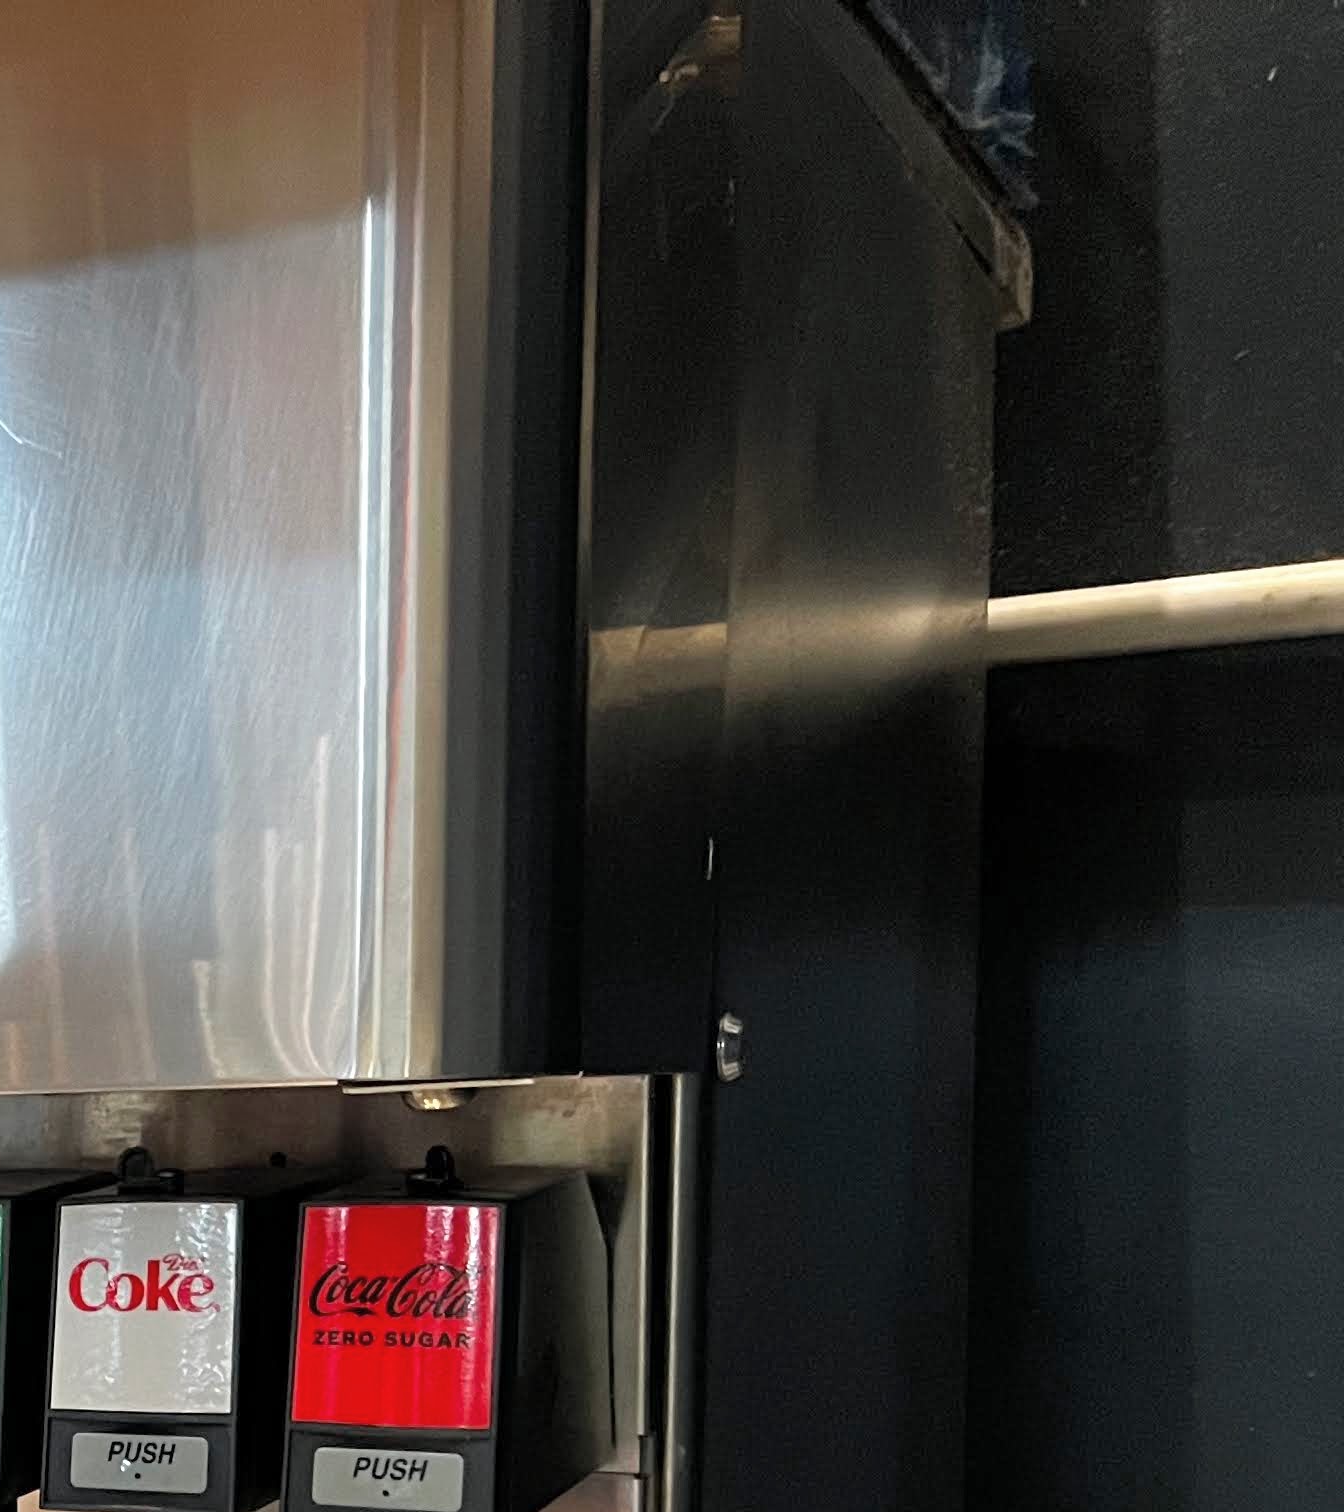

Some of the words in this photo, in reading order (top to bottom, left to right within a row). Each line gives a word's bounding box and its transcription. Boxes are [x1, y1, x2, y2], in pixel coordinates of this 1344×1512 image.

[68, 1256, 216, 1313] Coke
[314, 1330, 374, 1347] ZERO
[384, 1331, 471, 1349] SUGAR
[108, 1441, 177, 1465] PUSH
[352, 1456, 429, 1482] PUSH
